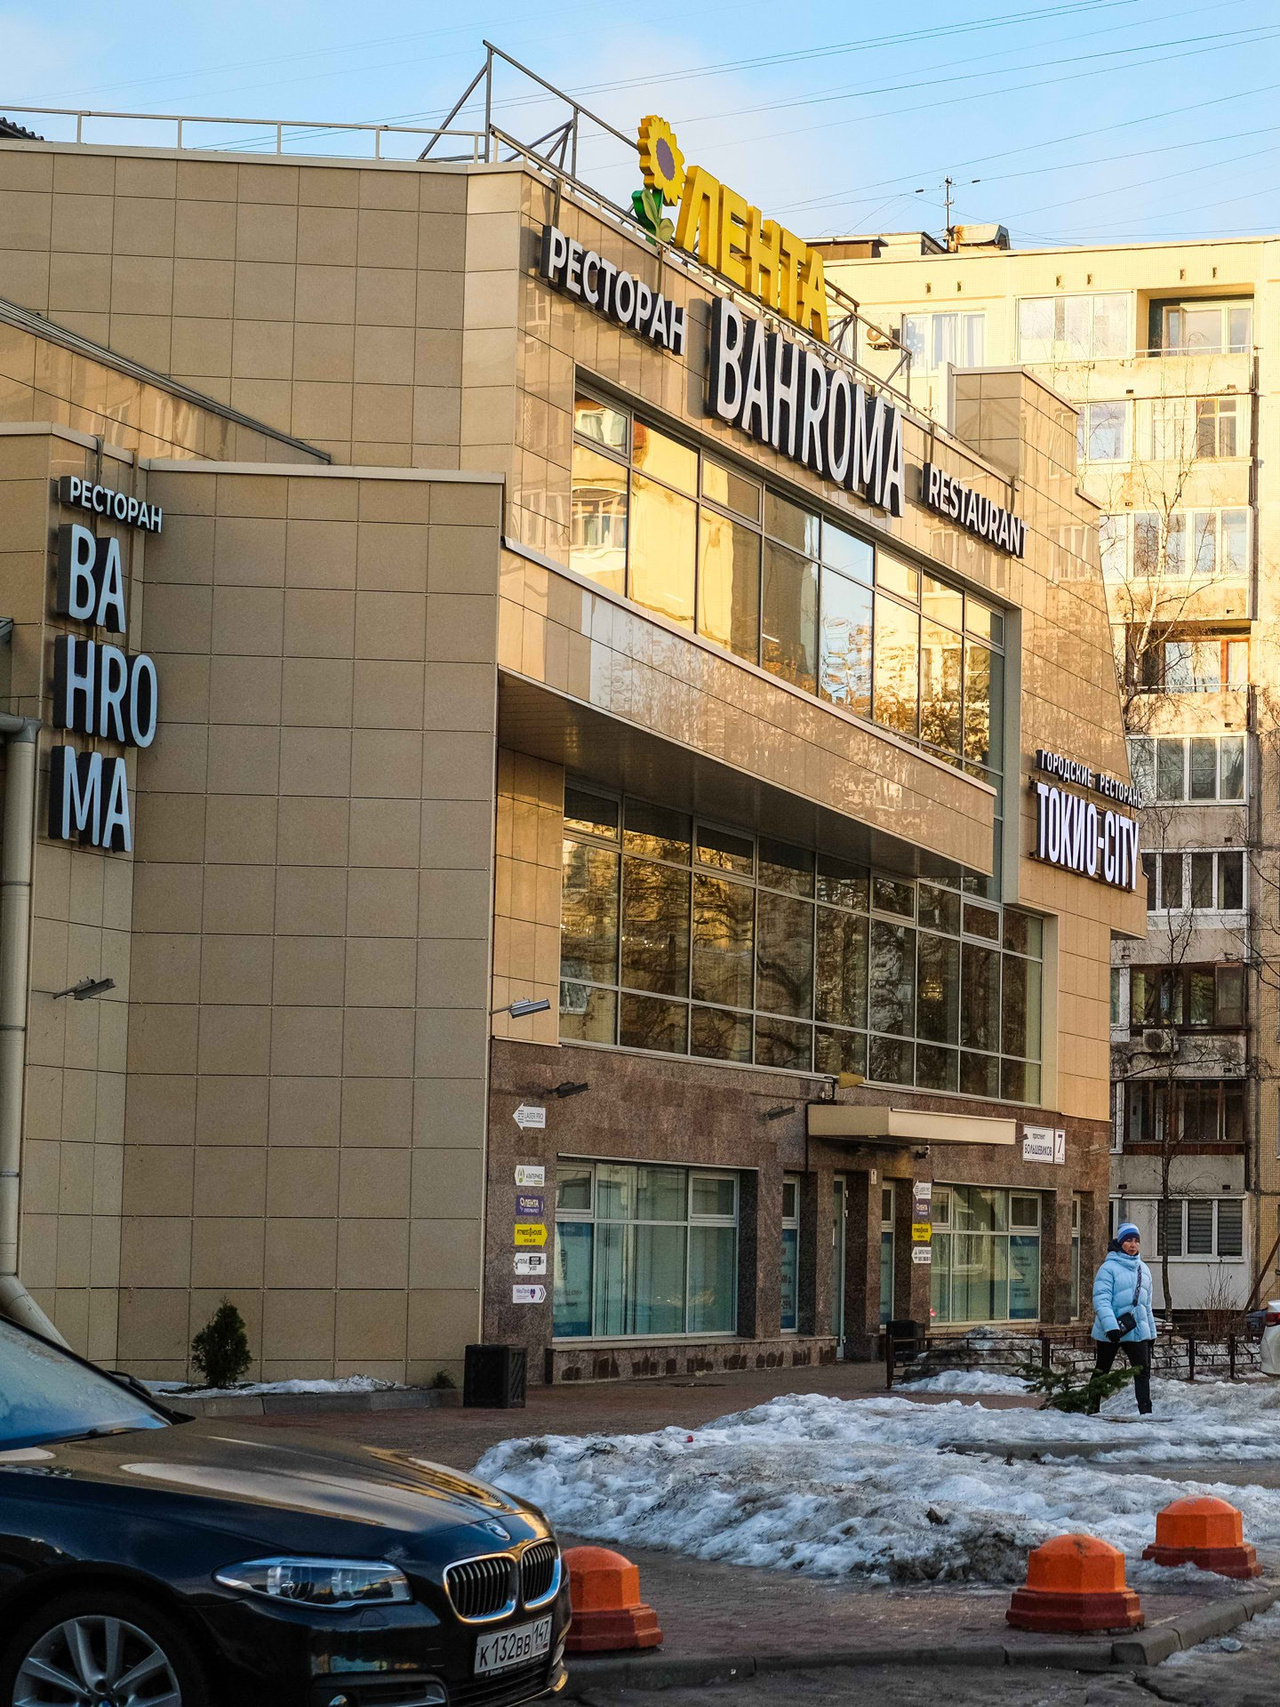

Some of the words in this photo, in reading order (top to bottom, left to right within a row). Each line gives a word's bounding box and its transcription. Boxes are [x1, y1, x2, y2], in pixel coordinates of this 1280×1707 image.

[546, 226, 686, 355] РЕСТОРАН
[674, 165, 830, 342] ЛЕНТА
[712, 298, 904, 517] BAHROMA
[67, 476, 163, 533] РЕСТОРАН
[927, 463, 1029, 557] RESTAURANT
[64, 523, 126, 633] BA
[61, 634, 158, 748] HRO
[57, 745, 132, 852] MA
[1040, 750, 1093, 787] ГОРОДСКИЕ
[1099, 773, 1142, 809] РЕСТОРАНЫ
[1036, 782, 1140, 890] ТОКИО-CITY
[1057, 1133, 1063, 1154] 7
